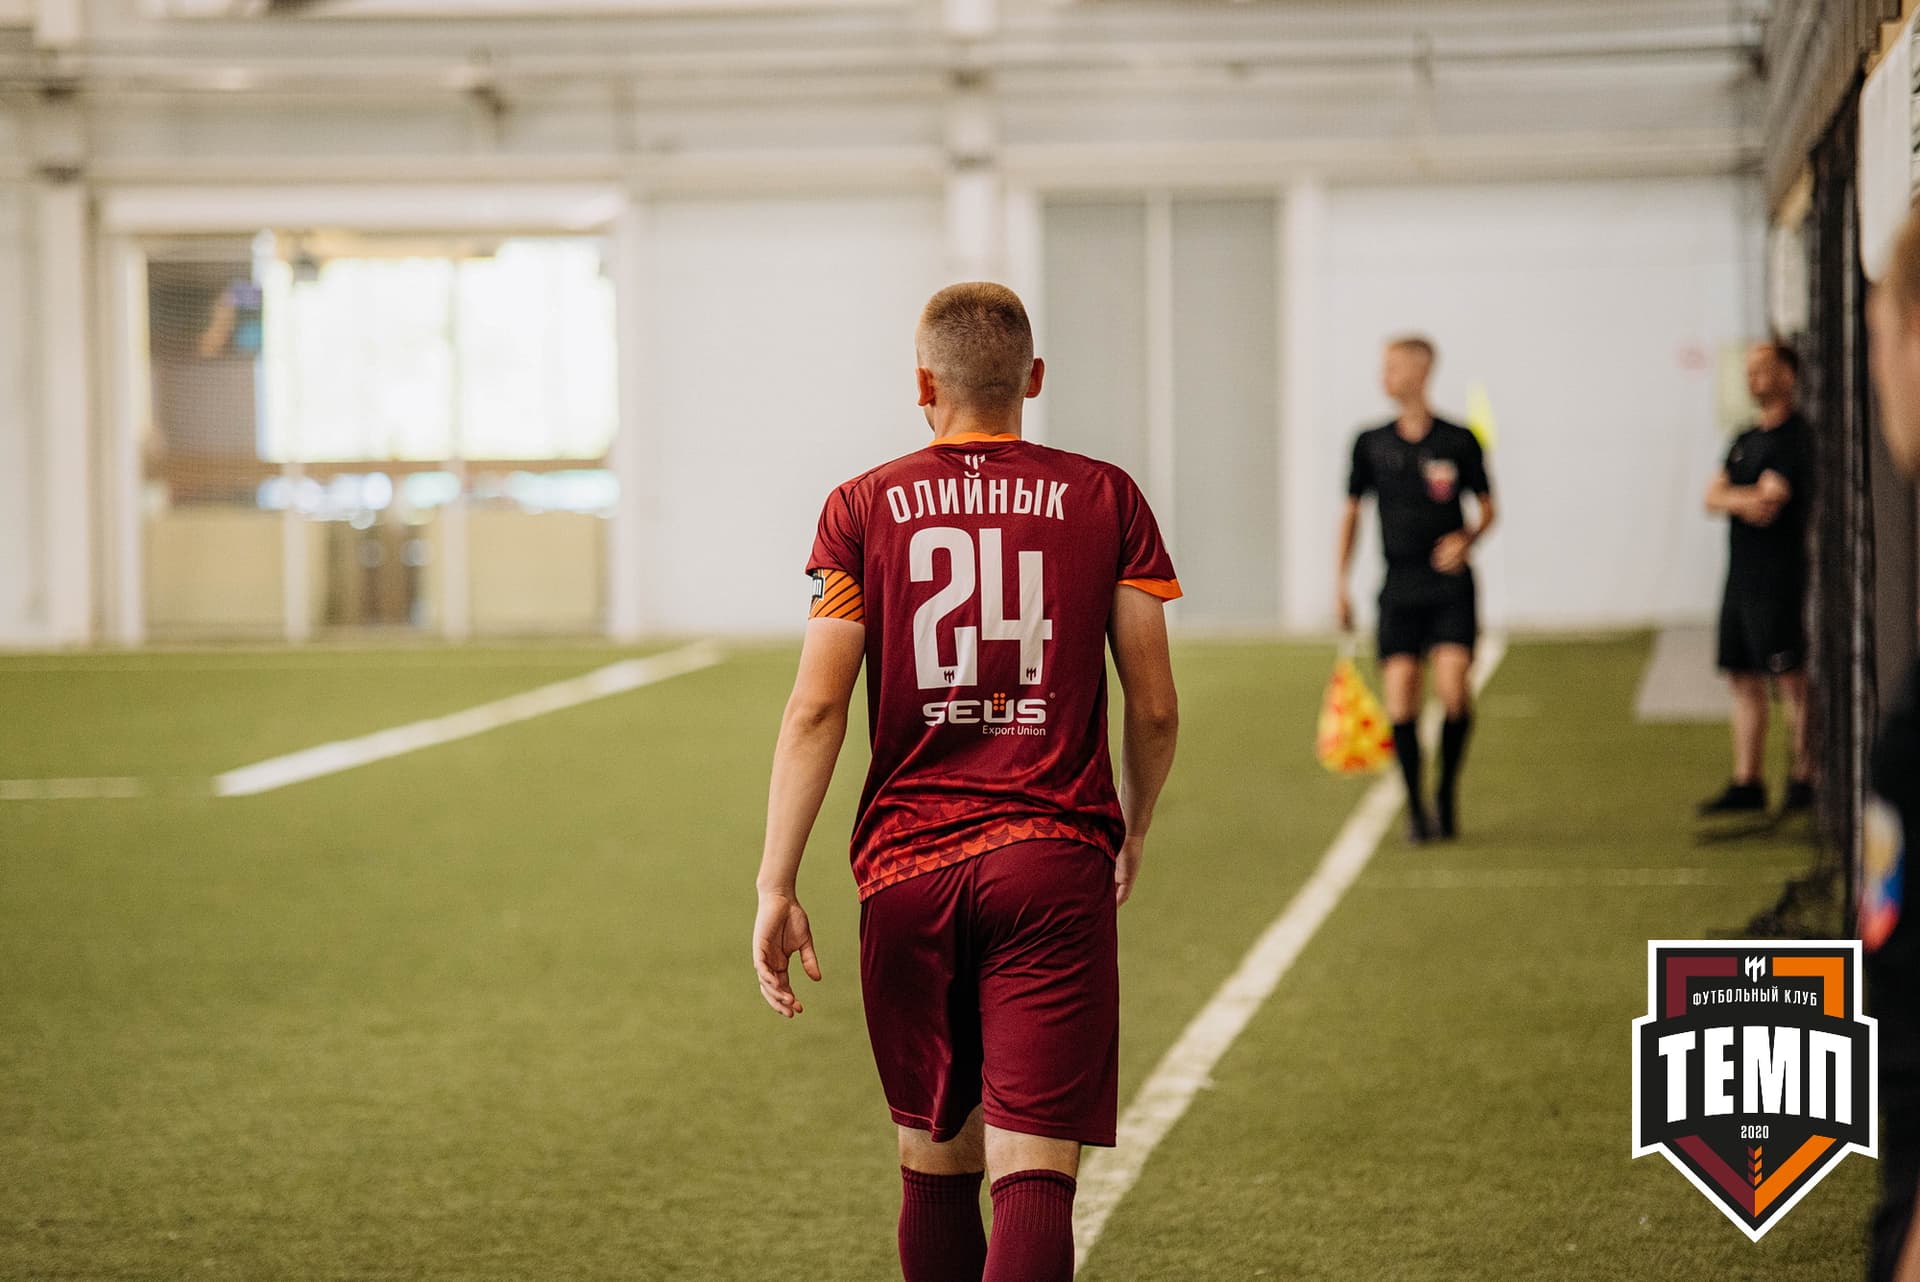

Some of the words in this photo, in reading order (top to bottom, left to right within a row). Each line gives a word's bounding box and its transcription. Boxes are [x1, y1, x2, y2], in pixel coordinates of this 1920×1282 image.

[886, 470, 1069, 524] ОЛИЙНЫК
[908, 526, 1053, 690] 24
[982, 725, 1015, 736] Export
[1017, 726, 1046, 736] Union
